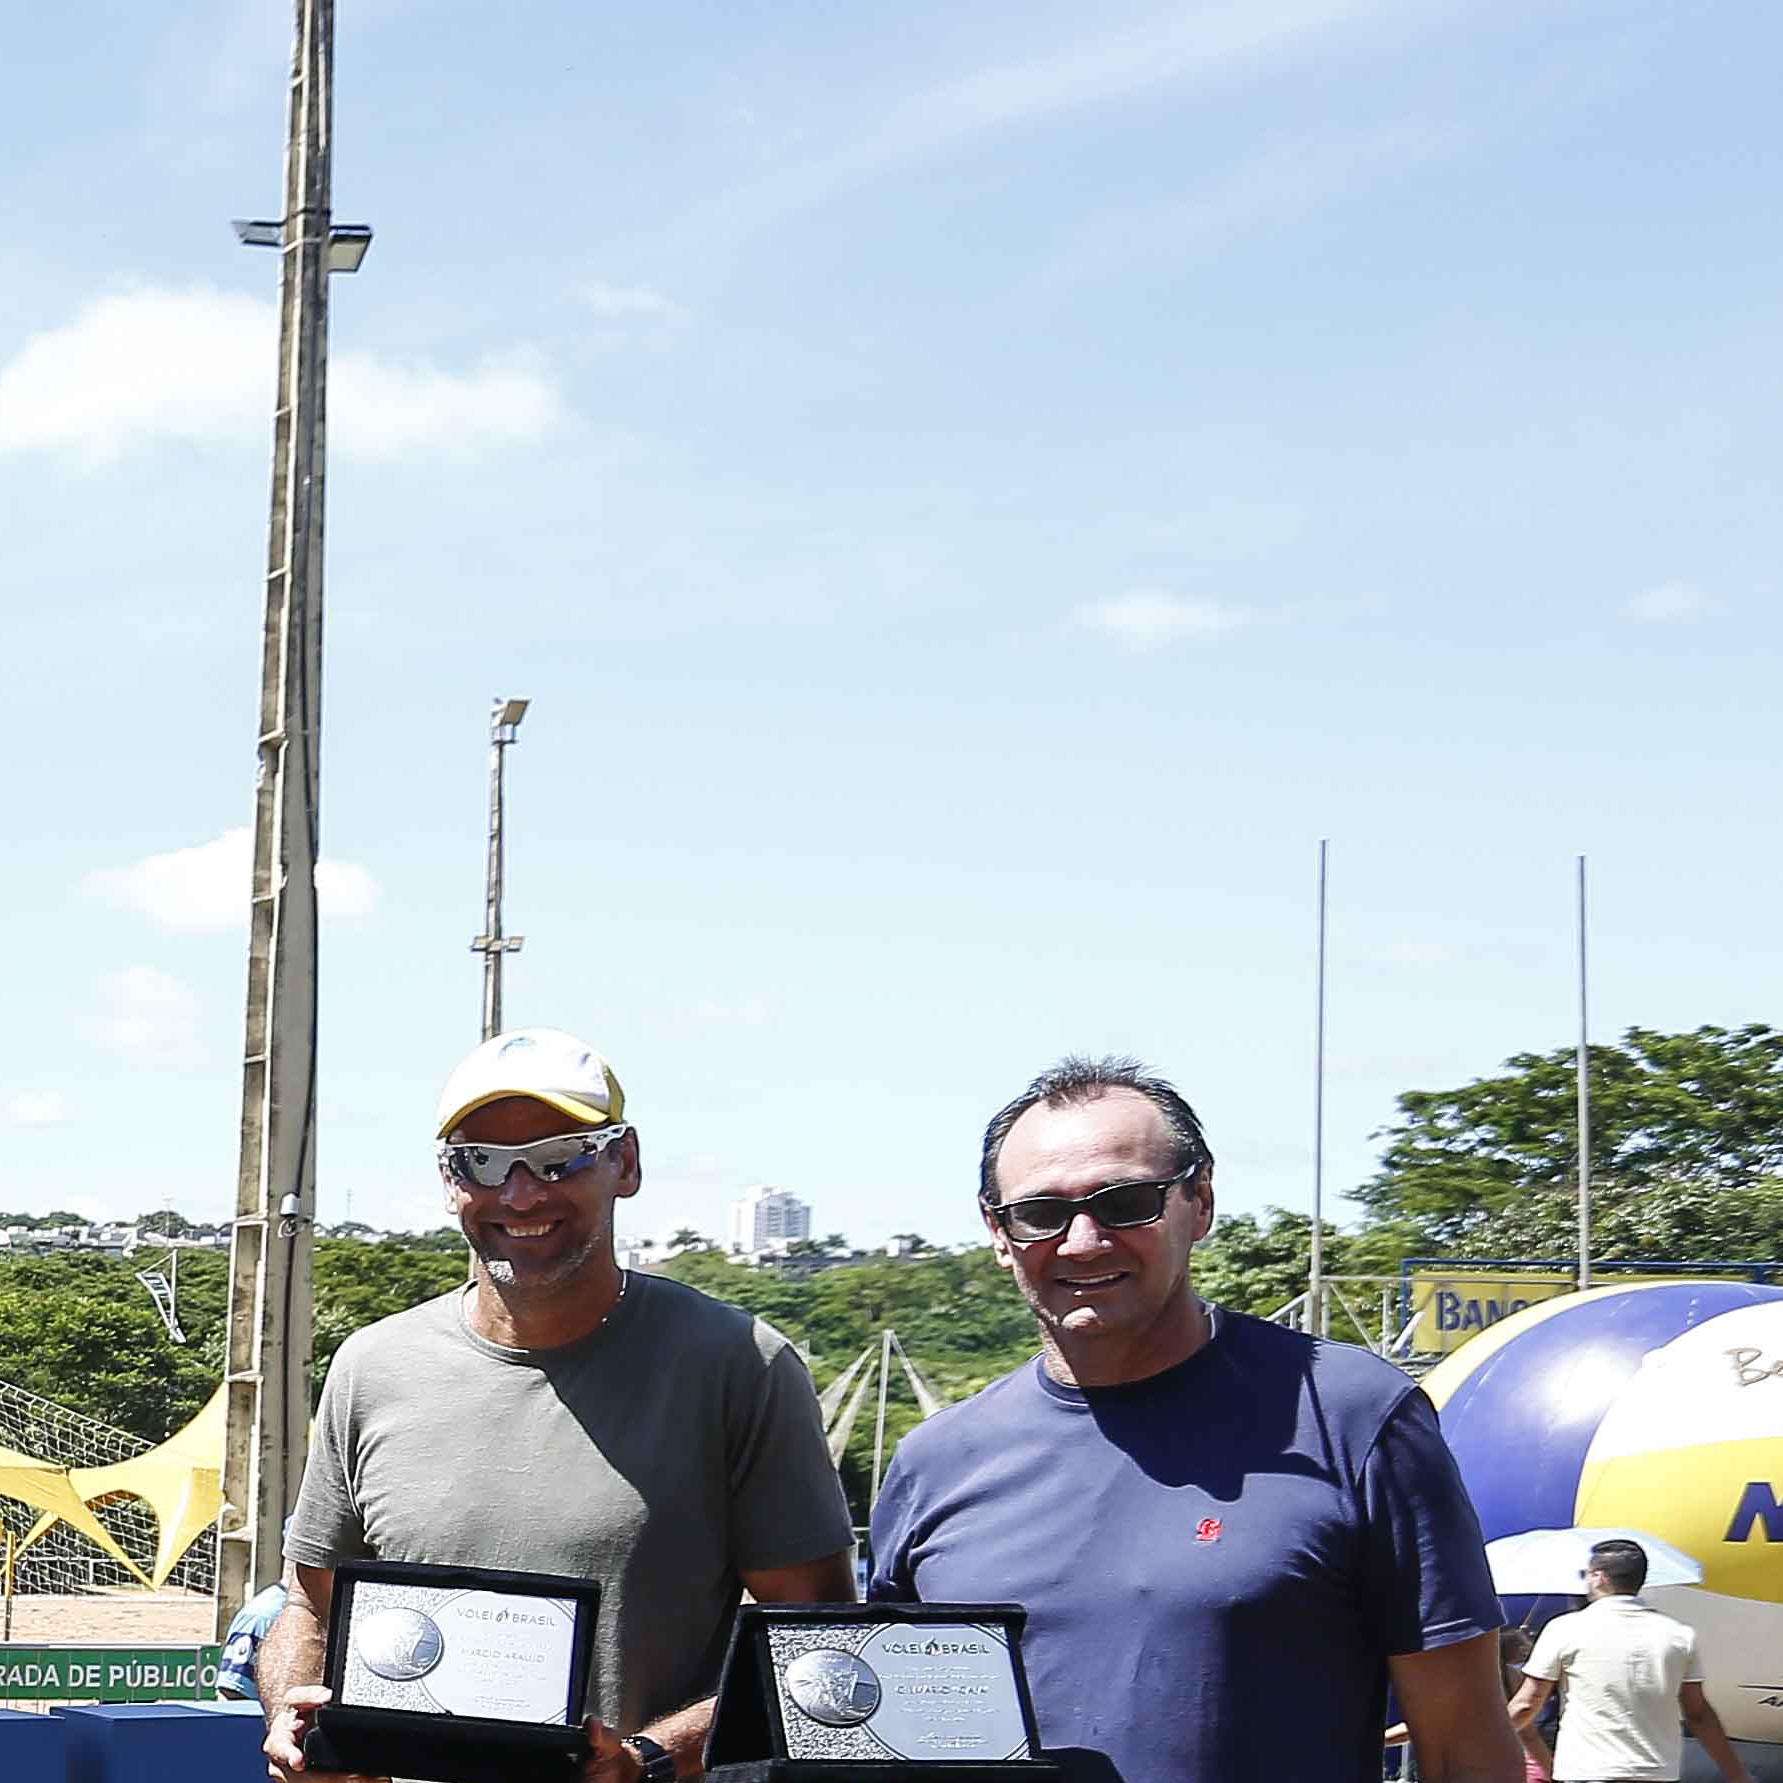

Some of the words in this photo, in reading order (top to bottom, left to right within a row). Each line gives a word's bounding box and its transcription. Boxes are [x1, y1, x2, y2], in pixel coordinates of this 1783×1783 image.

[512, 1613, 556, 1627] BRASIL
[943, 1643, 991, 1655] BRASIL
[68, 1664, 101, 1687] DE
[108, 1659, 218, 1689] PÚBLICO
